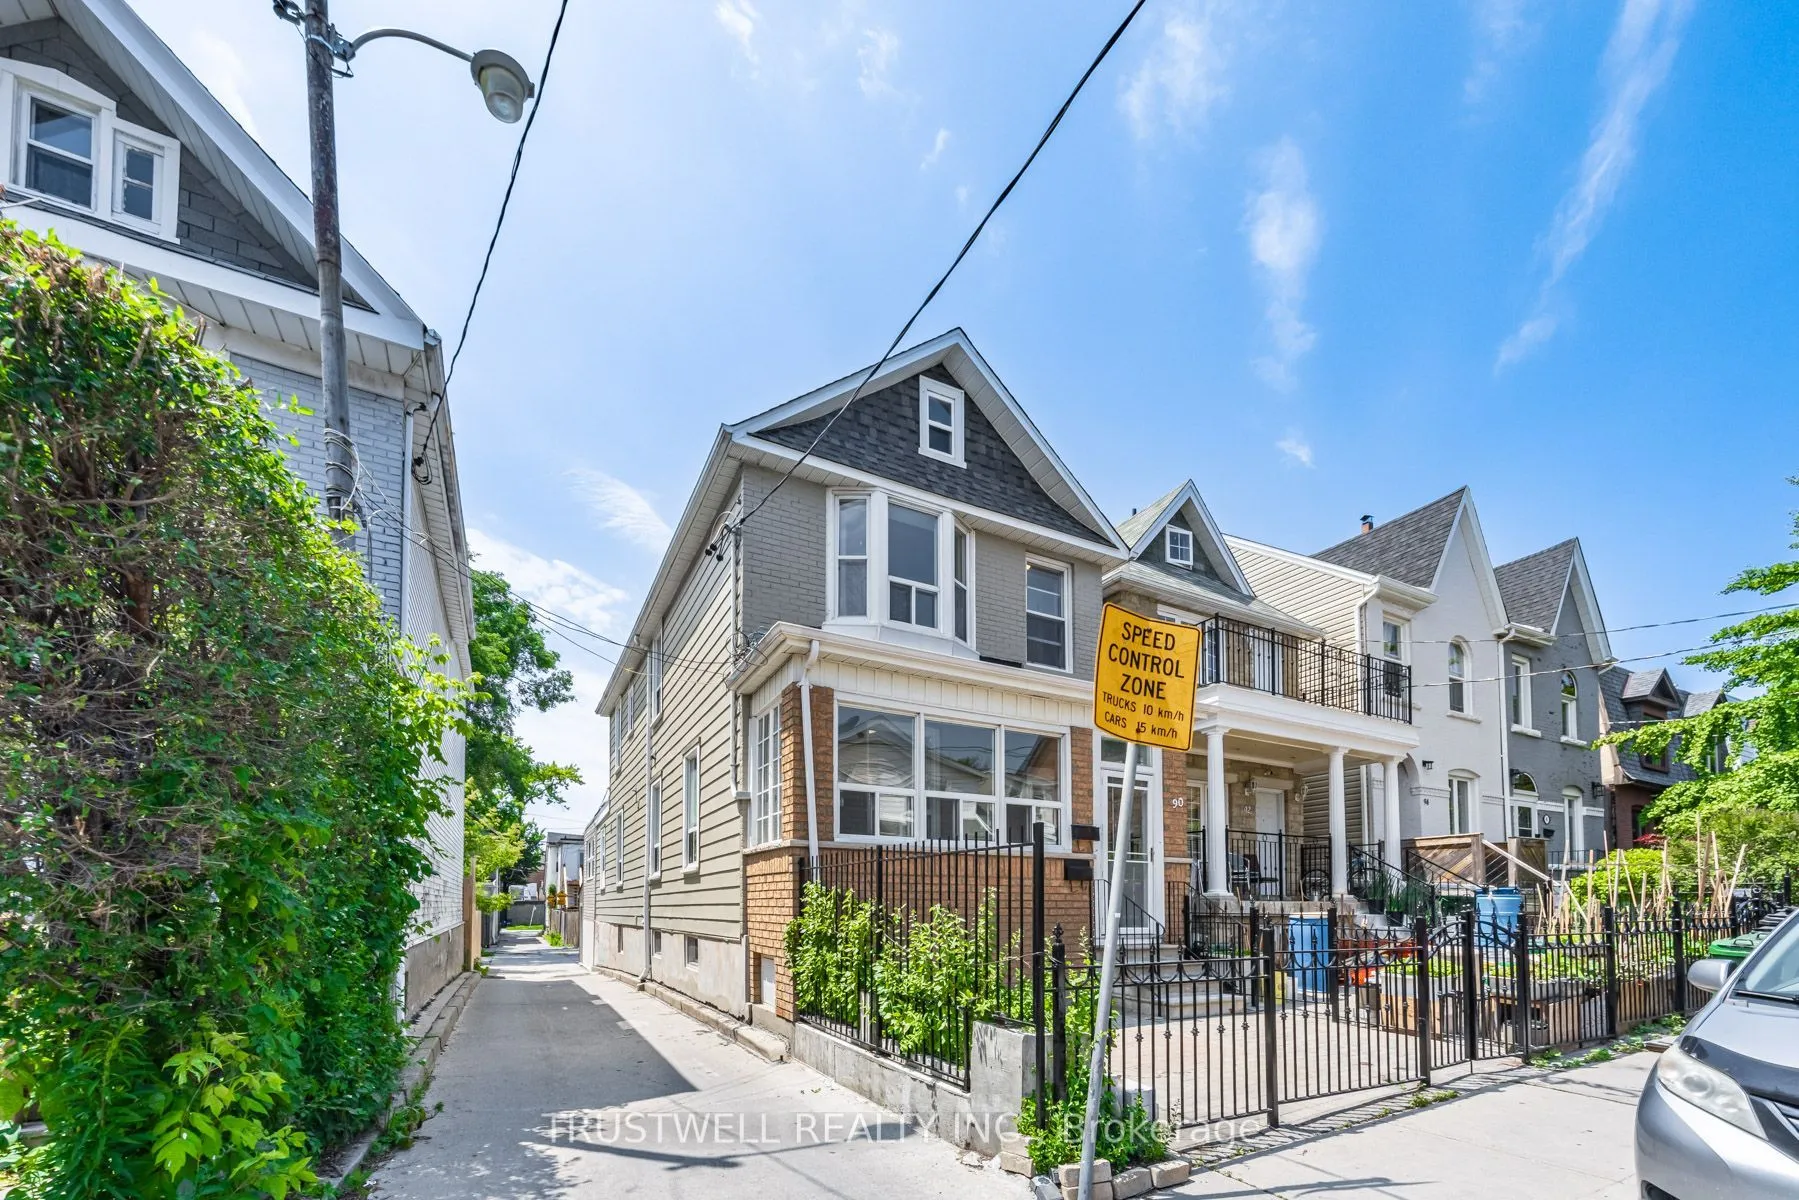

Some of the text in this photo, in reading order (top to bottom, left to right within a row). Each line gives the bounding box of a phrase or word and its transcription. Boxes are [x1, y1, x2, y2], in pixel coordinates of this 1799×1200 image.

[1121, 622, 1175, 651] SPEED
[1108, 644, 1184, 678] CONTROL
[1120, 674, 1166, 700] ZONE
[1103, 691, 1184, 722] TRUCKS 10 km/h
[1104, 712, 1177, 739] CARS 15 km/h
[1172, 797, 1184, 808] 90
